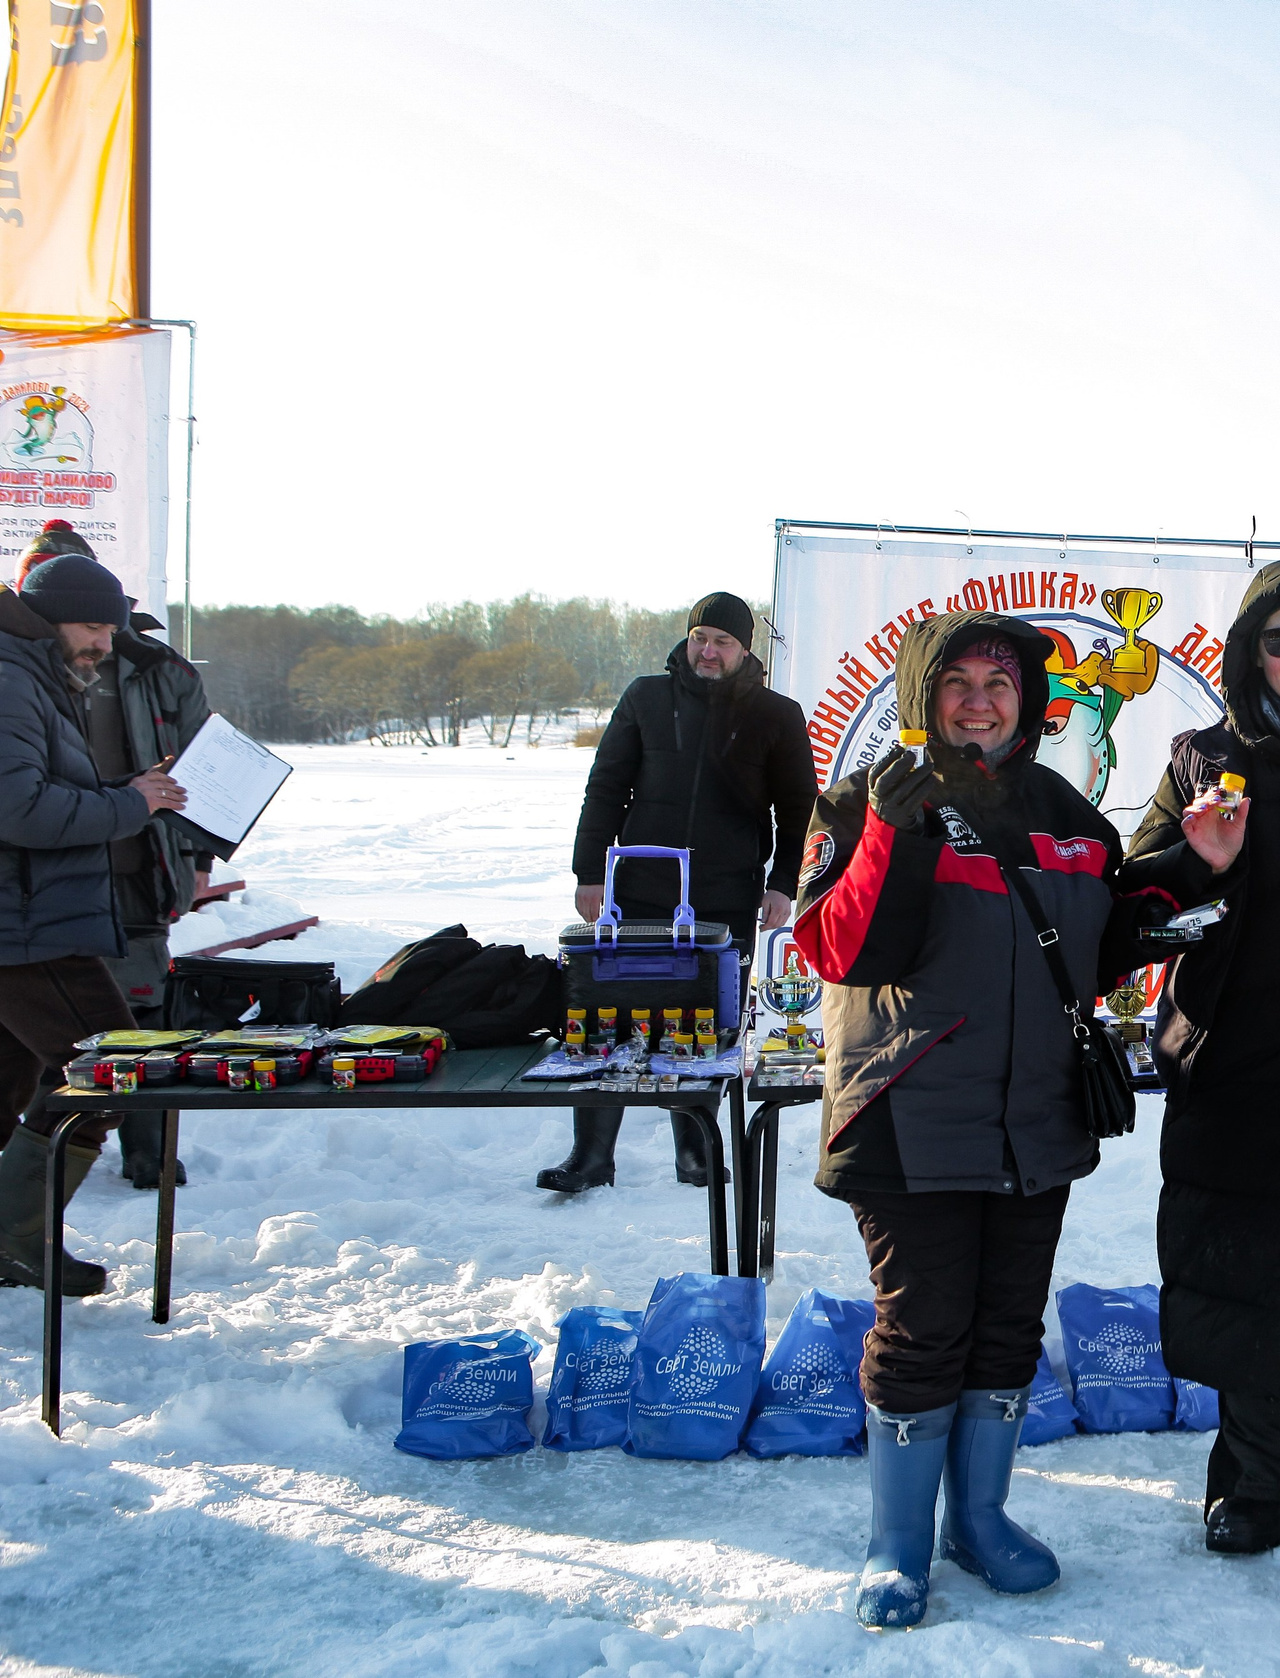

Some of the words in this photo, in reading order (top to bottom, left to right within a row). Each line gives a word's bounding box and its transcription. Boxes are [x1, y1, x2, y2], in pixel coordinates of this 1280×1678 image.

[0, 470, 114, 490] ИШКЕ-ДАНИЛОВО
[44, 491, 92, 506] ЖАРКО!
[1078, 1338, 1111, 1353] Свет
[1115, 1340, 1163, 1355] Земли
[600, 1353, 635, 1368] Зем
[655, 1355, 689, 1374] Свет
[690, 1352, 742, 1377] Земли
[464, 1367, 518, 1382] Земли
[771, 1370, 807, 1391] Свет
[1078, 1380, 1113, 1390] ПОМОЩИ
[416, 1409, 455, 1418] ПОМОЩИ
[560, 1402, 592, 1412] ПООЩИ
[675, 1408, 733, 1421] СПОРТСМЕНАМ
[717, 1404, 740, 1414] ФОНД
[834, 1405, 857, 1414] ФОНД
